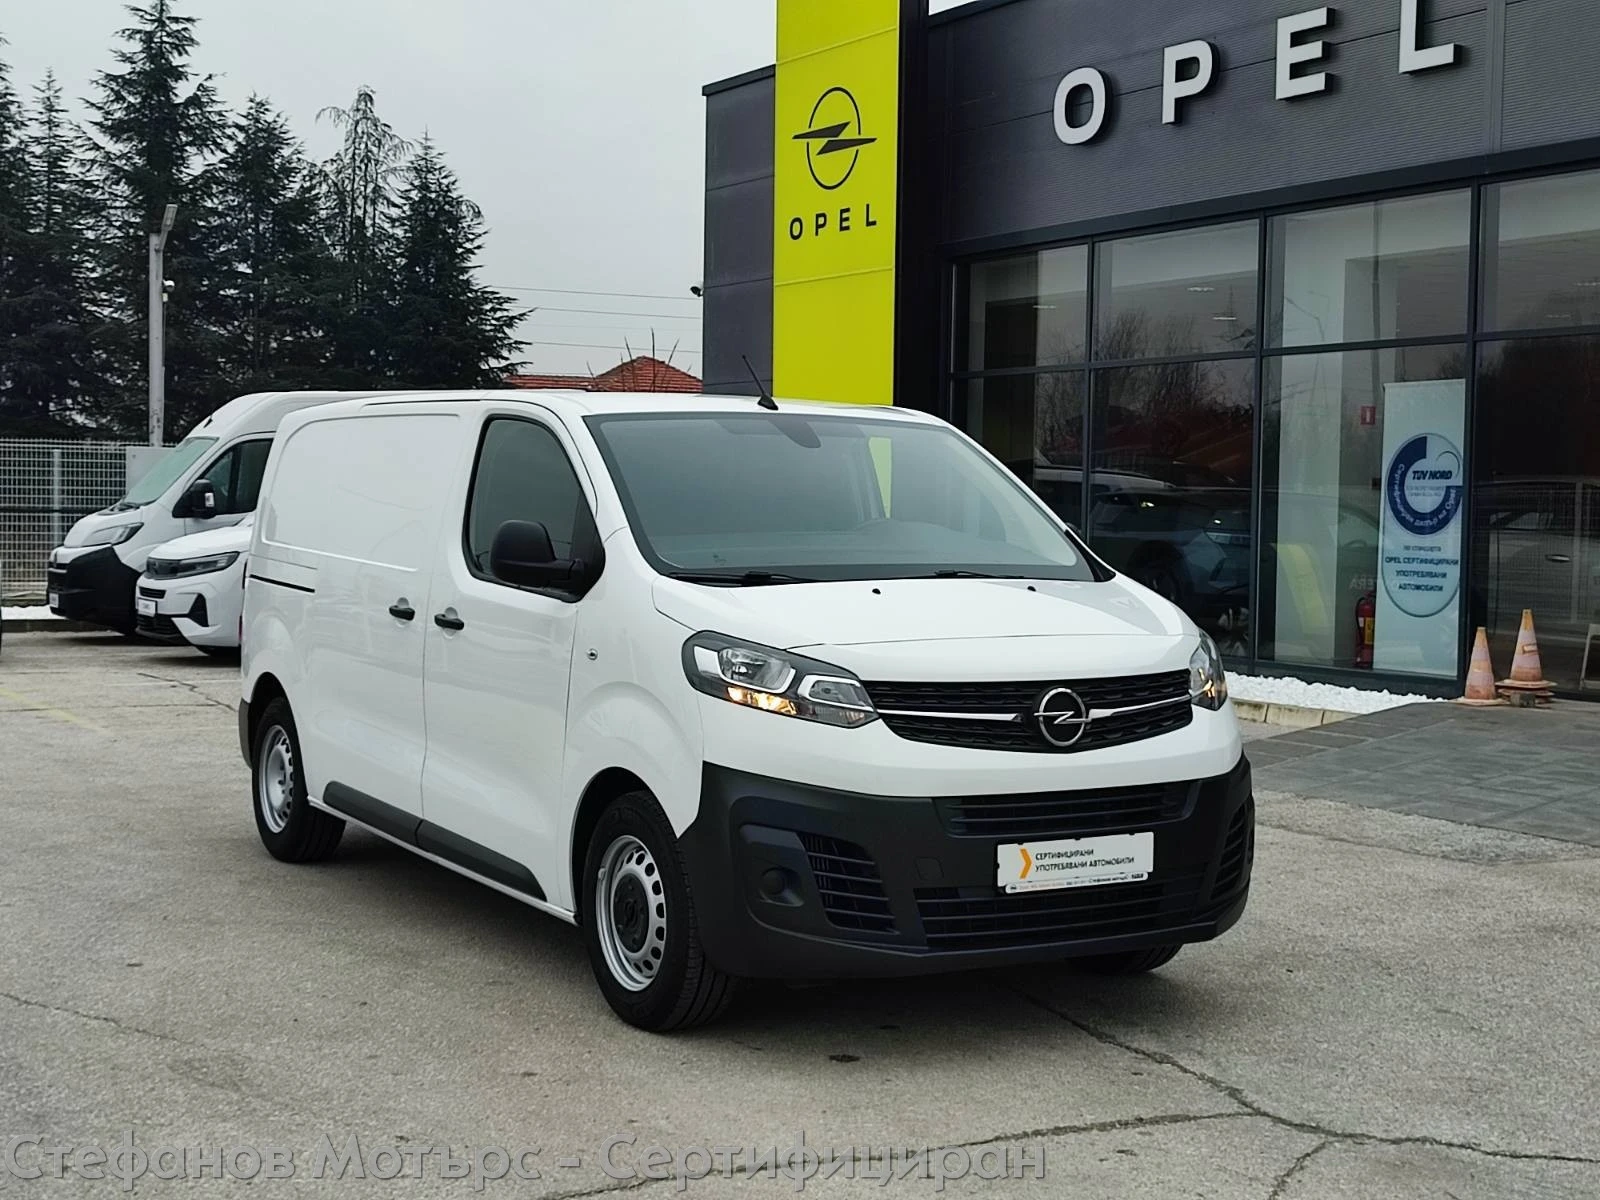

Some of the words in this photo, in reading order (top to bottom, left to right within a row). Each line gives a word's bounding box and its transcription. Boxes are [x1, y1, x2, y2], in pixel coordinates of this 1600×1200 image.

[1053, 0, 1458, 145] OPEL
[789, 203, 877, 241] OPEL
[1428, 470, 1453, 480] NORD
[1385, 556, 1401, 564] OPEL
[1398, 582, 1444, 592] АВТОМОБИЛИ
[1035, 848, 1094, 861] СЕРТИФИЦИРАНИ
[1035, 861, 1088, 873] УПОТРЕБЯВАНИ
[1088, 857, 1135, 868] АВТОМОБИЛИ
